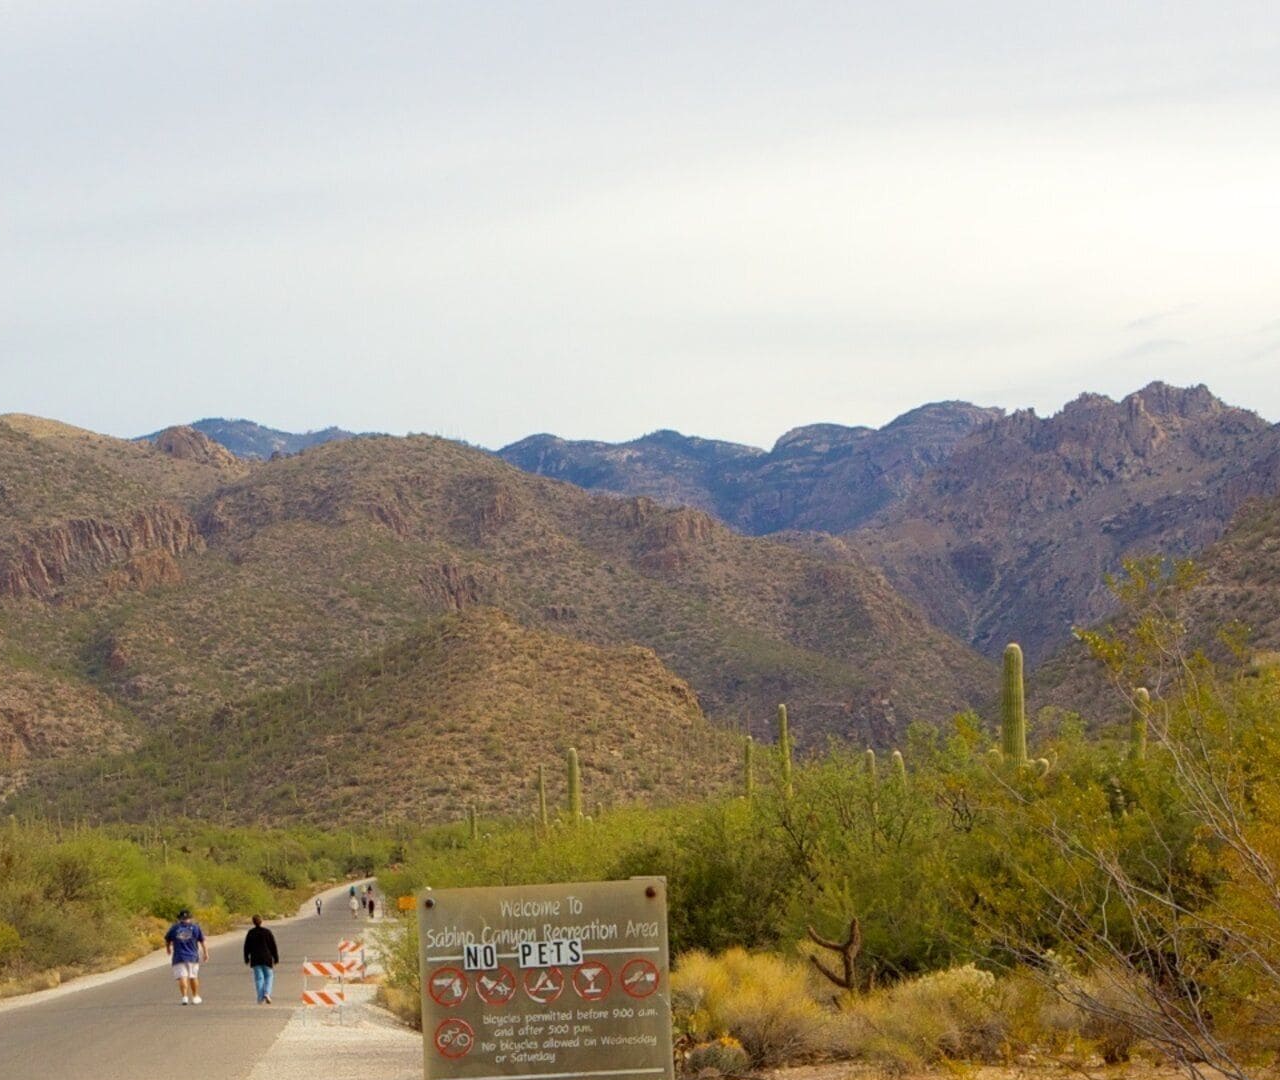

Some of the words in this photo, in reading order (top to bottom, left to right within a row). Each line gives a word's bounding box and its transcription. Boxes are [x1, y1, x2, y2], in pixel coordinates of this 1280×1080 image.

[499, 898, 561, 918] Welcome
[566, 896, 584, 915] To
[426, 926, 475, 949] Sabino
[481, 926, 538, 951] Canyon
[543, 918, 618, 941] Recreation
[625, 920, 659, 938] Area
[465, 945, 495, 969] NO
[521, 940, 581, 966] PETS
[525, 1010, 573, 1025] permitted
[576, 1008, 609, 1020] before
[612, 1007, 634, 1019] 9:00
[494, 1026, 514, 1037] and
[518, 1024, 544, 1036] after
[548, 1024, 569, 1035] 5:00
[481, 1041, 497, 1052] No
[500, 1038, 538, 1053] bicycles
[542, 1036, 580, 1049] allowed
[583, 1038, 597, 1047] on
[600, 1033, 657, 1047] Wednesday
[495, 1055, 507, 1063] or
[510, 1050, 556, 1064] Saturday
